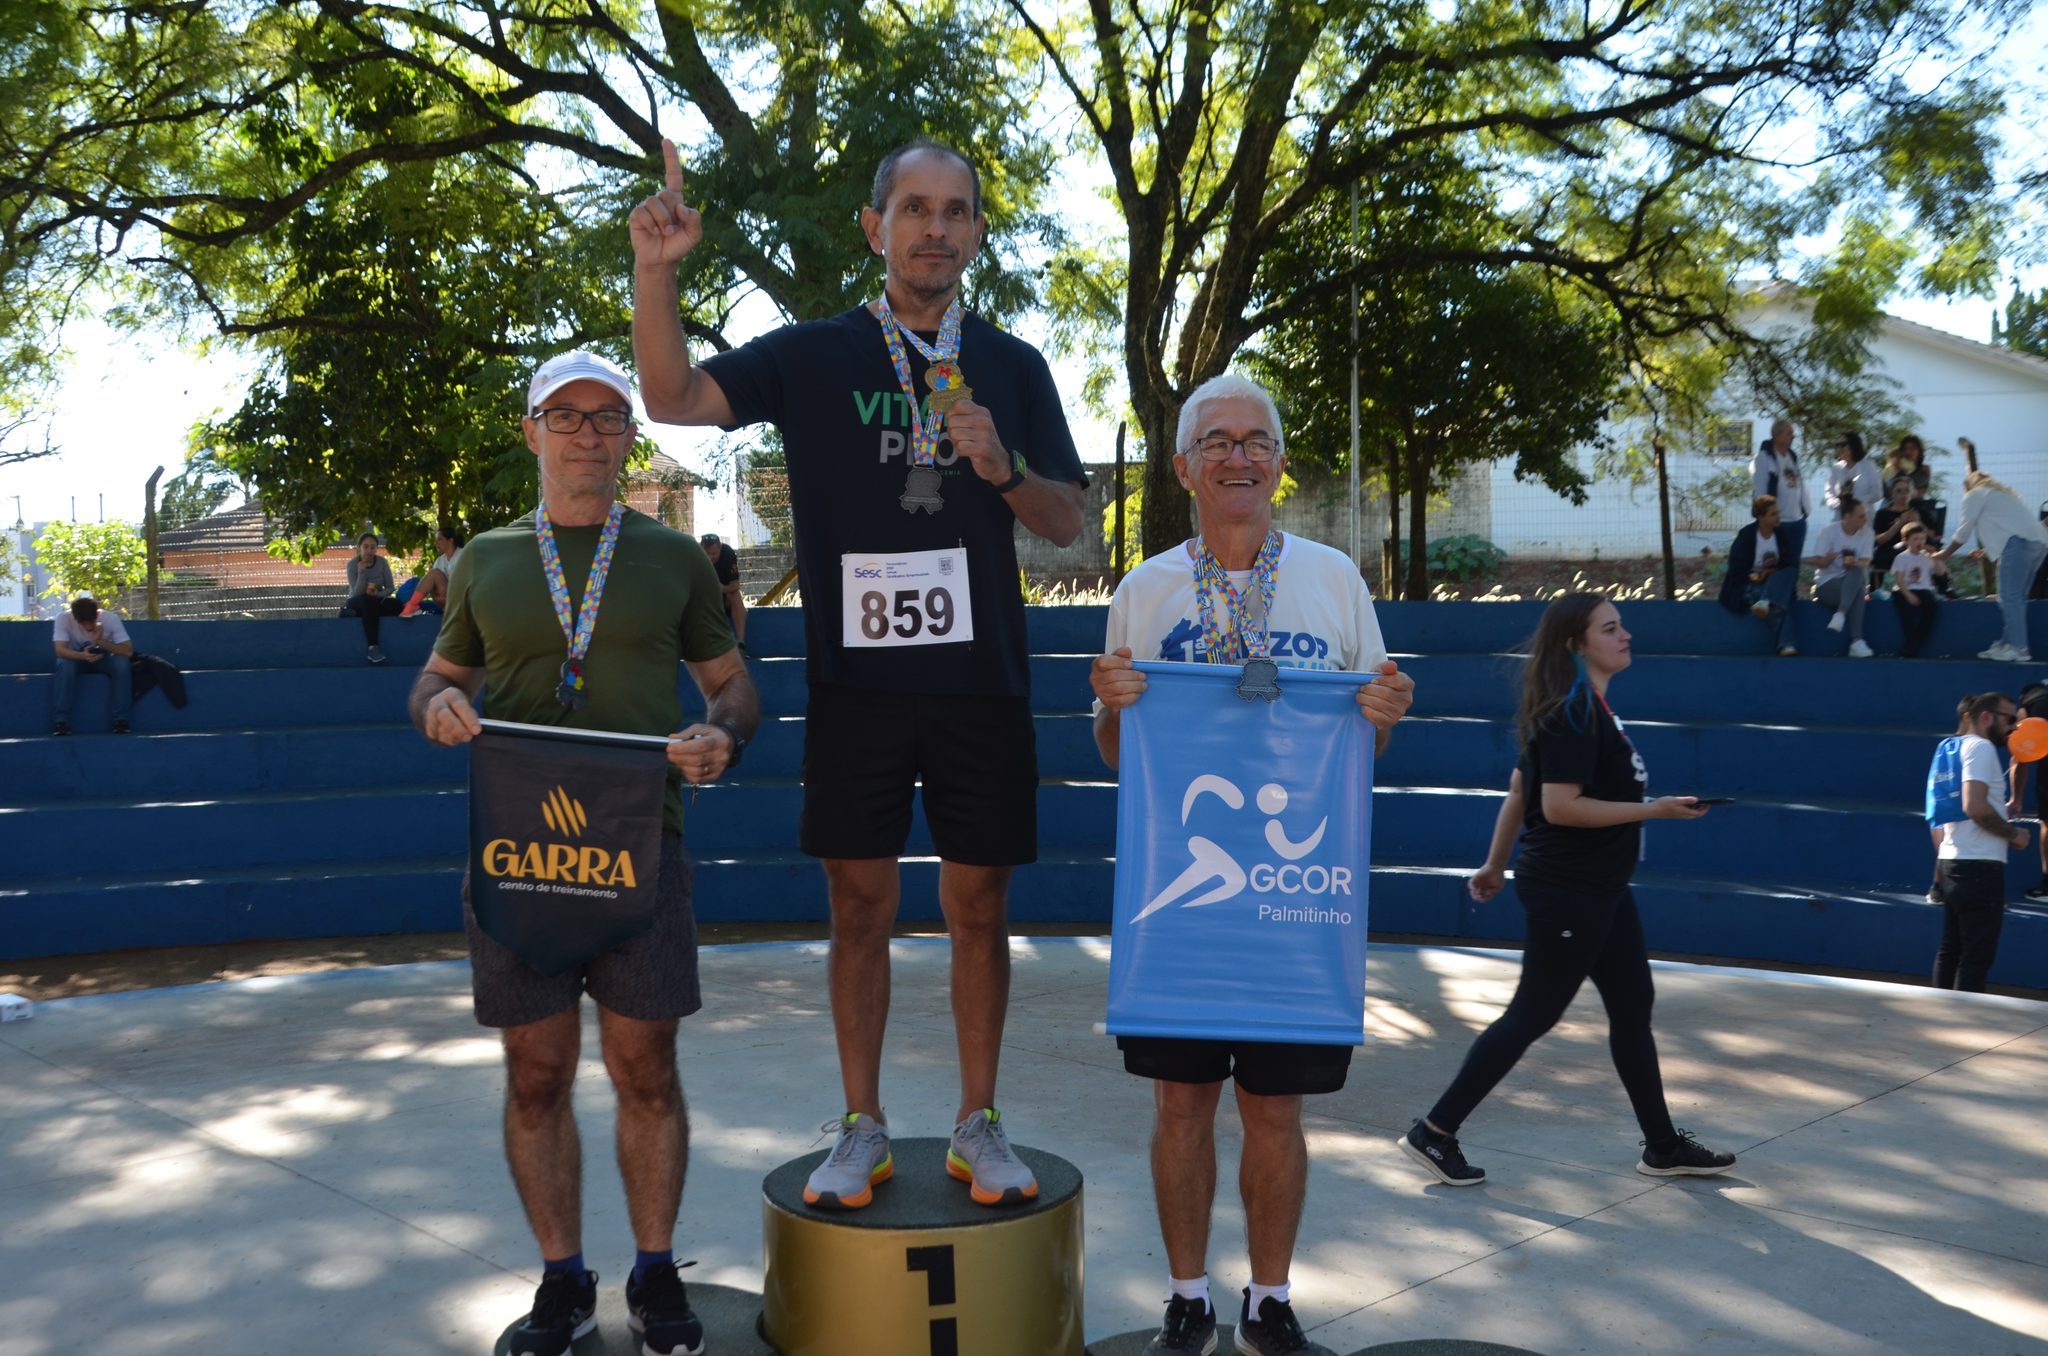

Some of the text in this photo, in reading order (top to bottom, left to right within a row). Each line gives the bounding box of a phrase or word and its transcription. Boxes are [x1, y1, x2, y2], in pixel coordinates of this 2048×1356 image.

[853, 390, 950, 427] VIT
[879, 430, 959, 467] PO
[854, 567, 882, 579] Sesc
[861, 586, 955, 640] 859
[482, 838, 637, 888] GARRA
[1249, 863, 1352, 896] GCOR
[498, 881, 619, 899] centro de treinamento
[1258, 904, 1352, 925] Palmitinho
